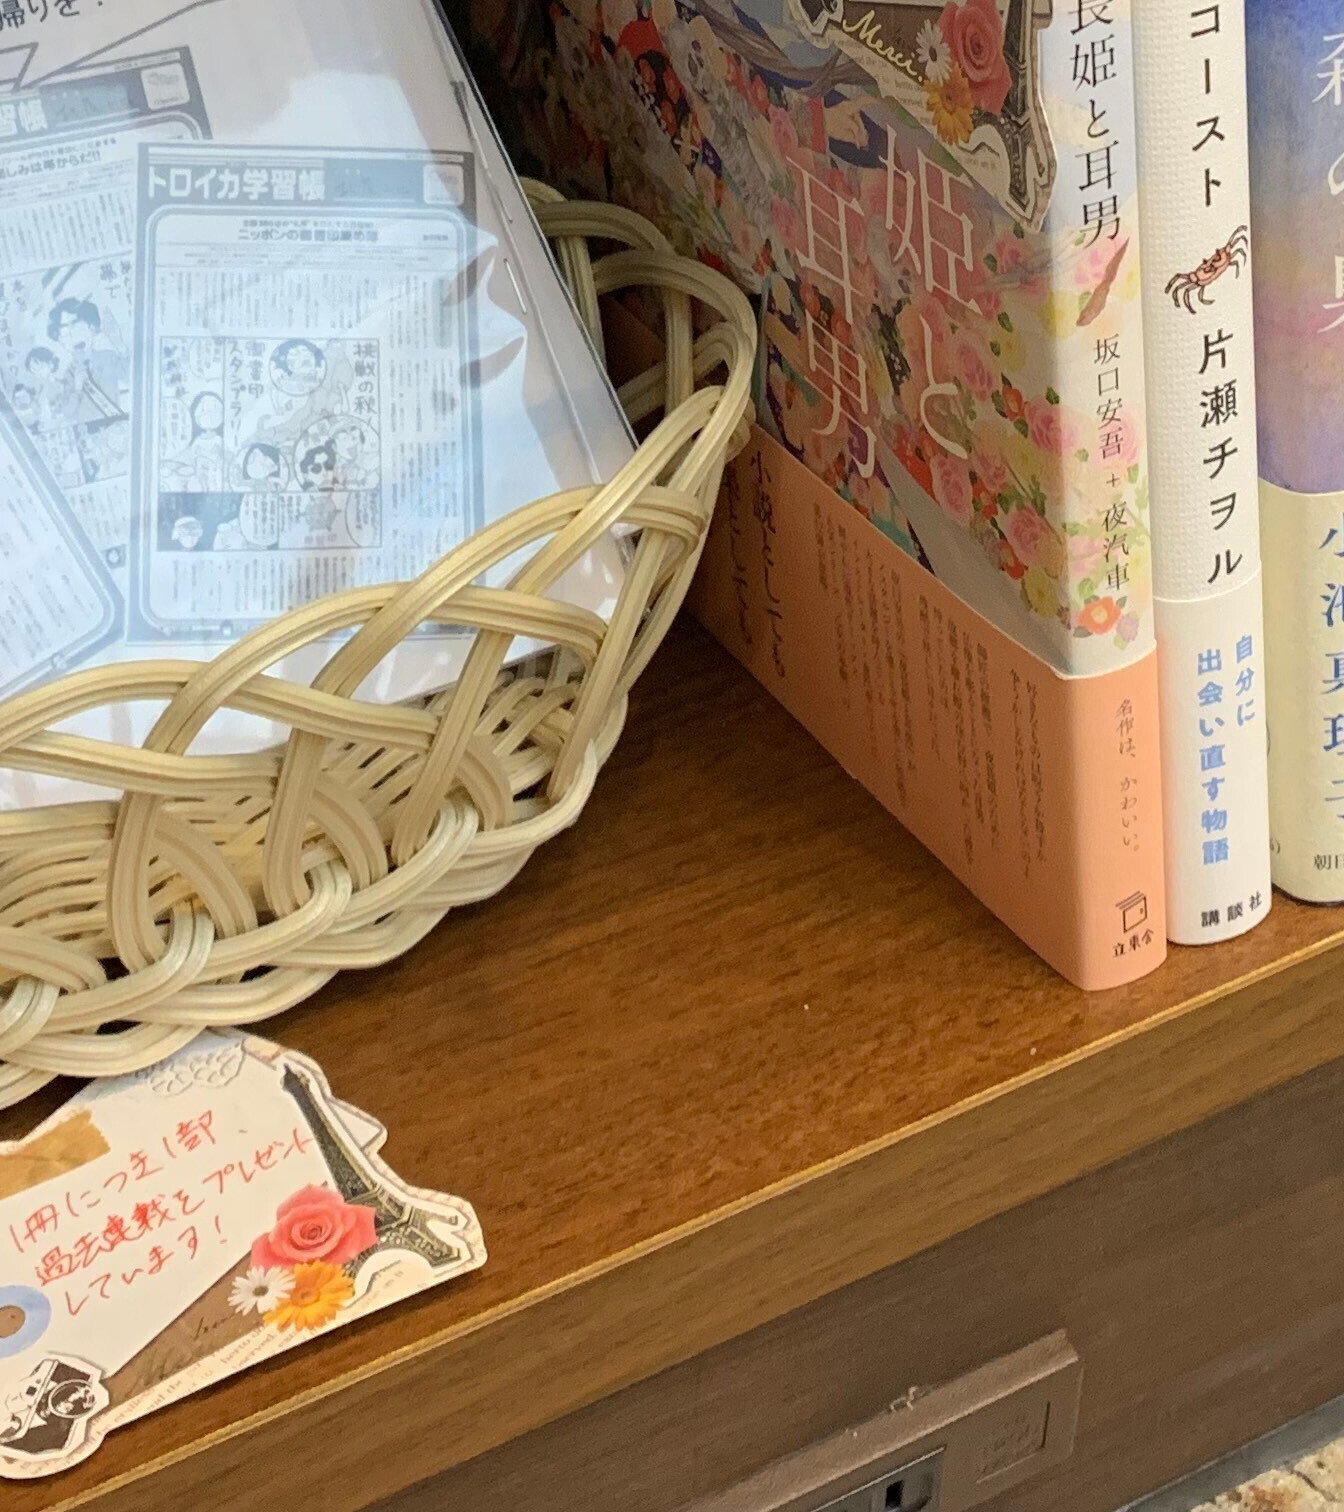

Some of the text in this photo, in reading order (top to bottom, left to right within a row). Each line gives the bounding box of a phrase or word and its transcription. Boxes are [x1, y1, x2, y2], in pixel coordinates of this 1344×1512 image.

[148, 167, 325, 200] トロイカ学習帳
[790, 149, 876, 480] 耳男
[1092, 336, 1127, 462] 坂口安吾
[1198, 328, 1244, 586] 片瀬チヲル
[1099, 506, 1132, 595] 夜汽車
[1234, 635, 1256, 725] 自分に
[1196, 648, 1231, 866] 出会い直す物語
[1201, 891, 1262, 928] 講談社
